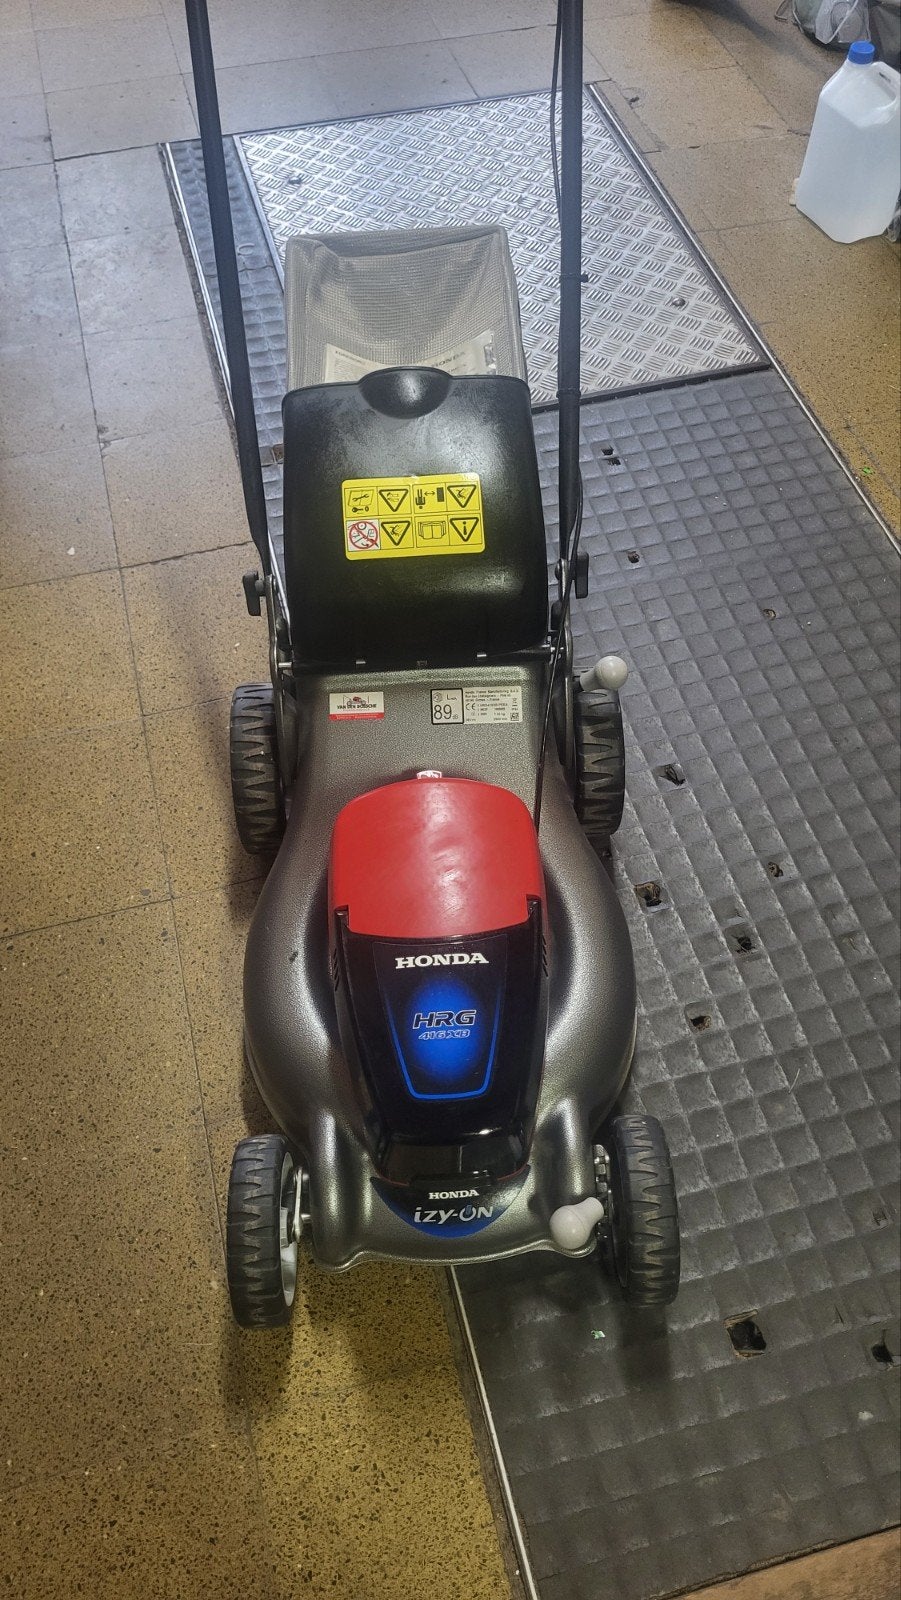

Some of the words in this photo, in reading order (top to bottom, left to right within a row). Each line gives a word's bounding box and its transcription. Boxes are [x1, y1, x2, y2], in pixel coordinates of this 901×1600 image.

[433, 704, 452, 720] 89
[395, 952, 489, 969] HONDA
[412, 1010, 477, 1029] HRG
[418, 1029, 471, 1041] 416XB
[428, 1189, 480, 1200] HONDA
